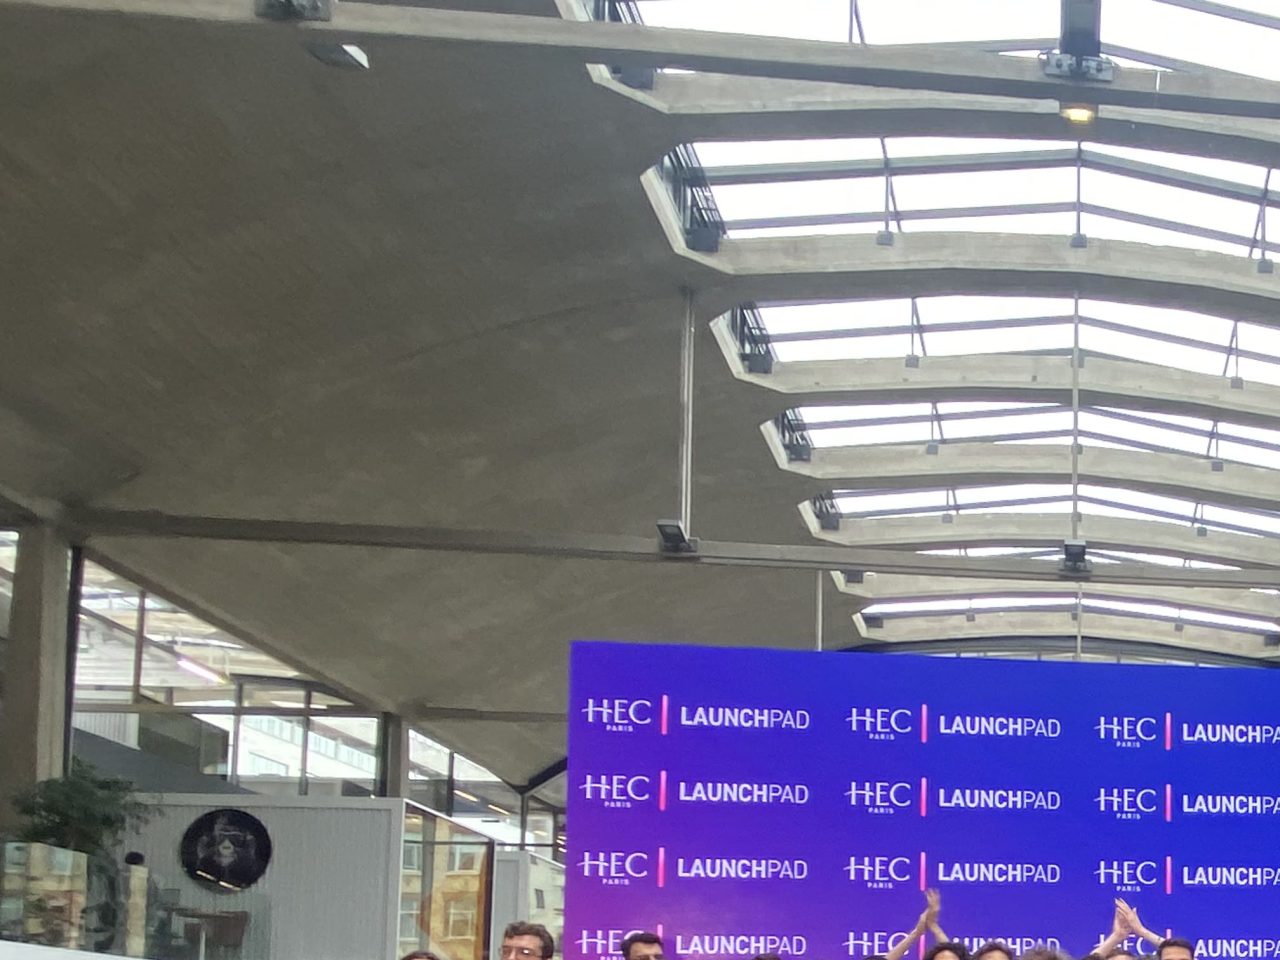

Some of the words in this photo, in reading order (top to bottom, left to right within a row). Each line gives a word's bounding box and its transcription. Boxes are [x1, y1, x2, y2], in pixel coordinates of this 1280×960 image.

[581, 699, 651, 724] HEC
[680, 706, 810, 729] LAUNCHPAD
[844, 708, 912, 733] HEC
[939, 715, 1061, 738] LAUNCHPAD
[1094, 717, 1156, 741] HEC
[579, 775, 650, 801] HEC
[679, 781, 809, 803] LAUNCHPAD
[844, 781, 911, 806] HEC
[939, 788, 1061, 810] LAUNCHPAD
[1094, 788, 1156, 812] HEC
[577, 851, 648, 878] HEC
[677, 858, 808, 879] LAUNCHPAD
[843, 857, 910, 882] HEC
[938, 863, 1060, 883] LAUNCHPAD
[1094, 861, 1156, 885] HEC
[676, 935, 807, 956] LAUNCHPAD
